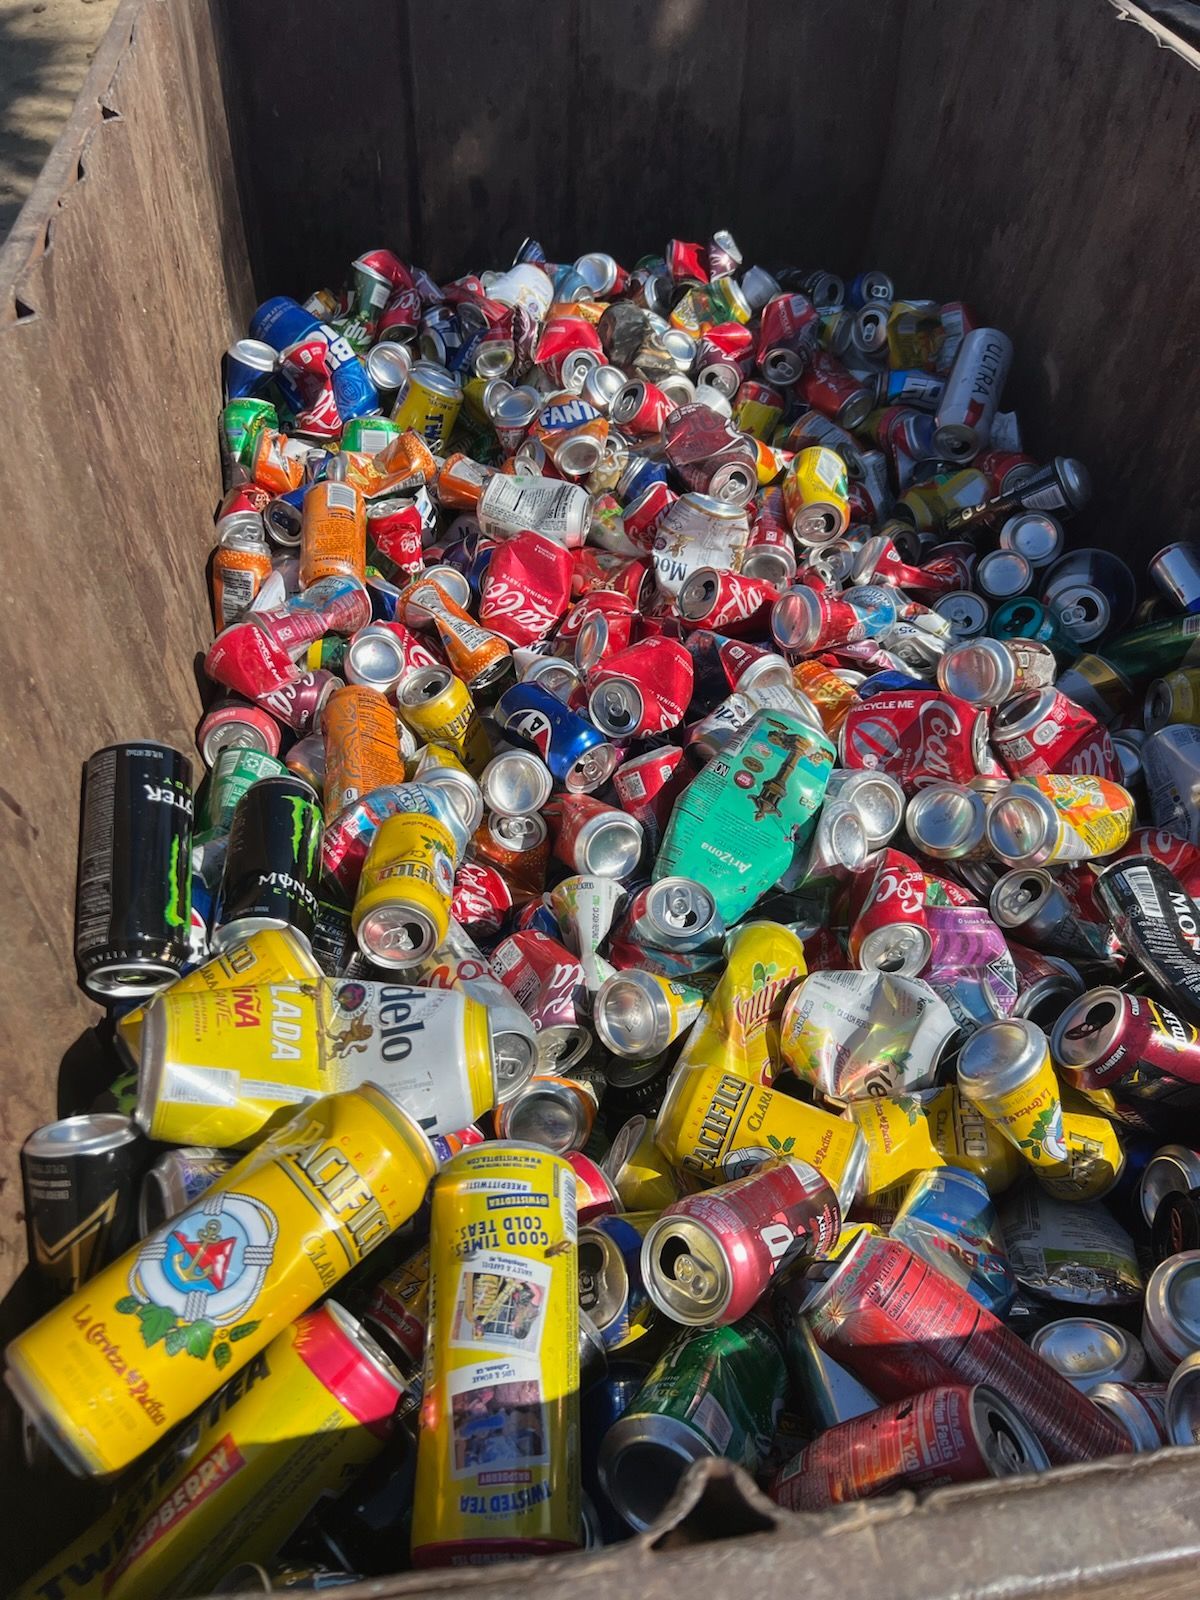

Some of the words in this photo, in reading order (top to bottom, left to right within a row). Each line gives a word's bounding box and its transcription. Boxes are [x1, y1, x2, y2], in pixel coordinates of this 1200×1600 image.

[970, 343, 996, 395] ULTRA
[522, 584, 553, 605] ORIGINAL
[252, 626, 275, 670] RECYCLE
[850, 700, 896, 713] RECYCLE
[897, 700, 914, 709] ME
[701, 842, 752, 876] AriZona
[1094, 1044, 1128, 1076] CRANBERRY
[746, 1090, 774, 1132] CLARA
[503, 1216, 542, 1231] COLD
[507, 1231, 549, 1246] GOOD
[902, 1442, 921, 1473] 120
[459, 1495, 487, 1515] TEA
[489, 1480, 553, 1514] TWISTED
